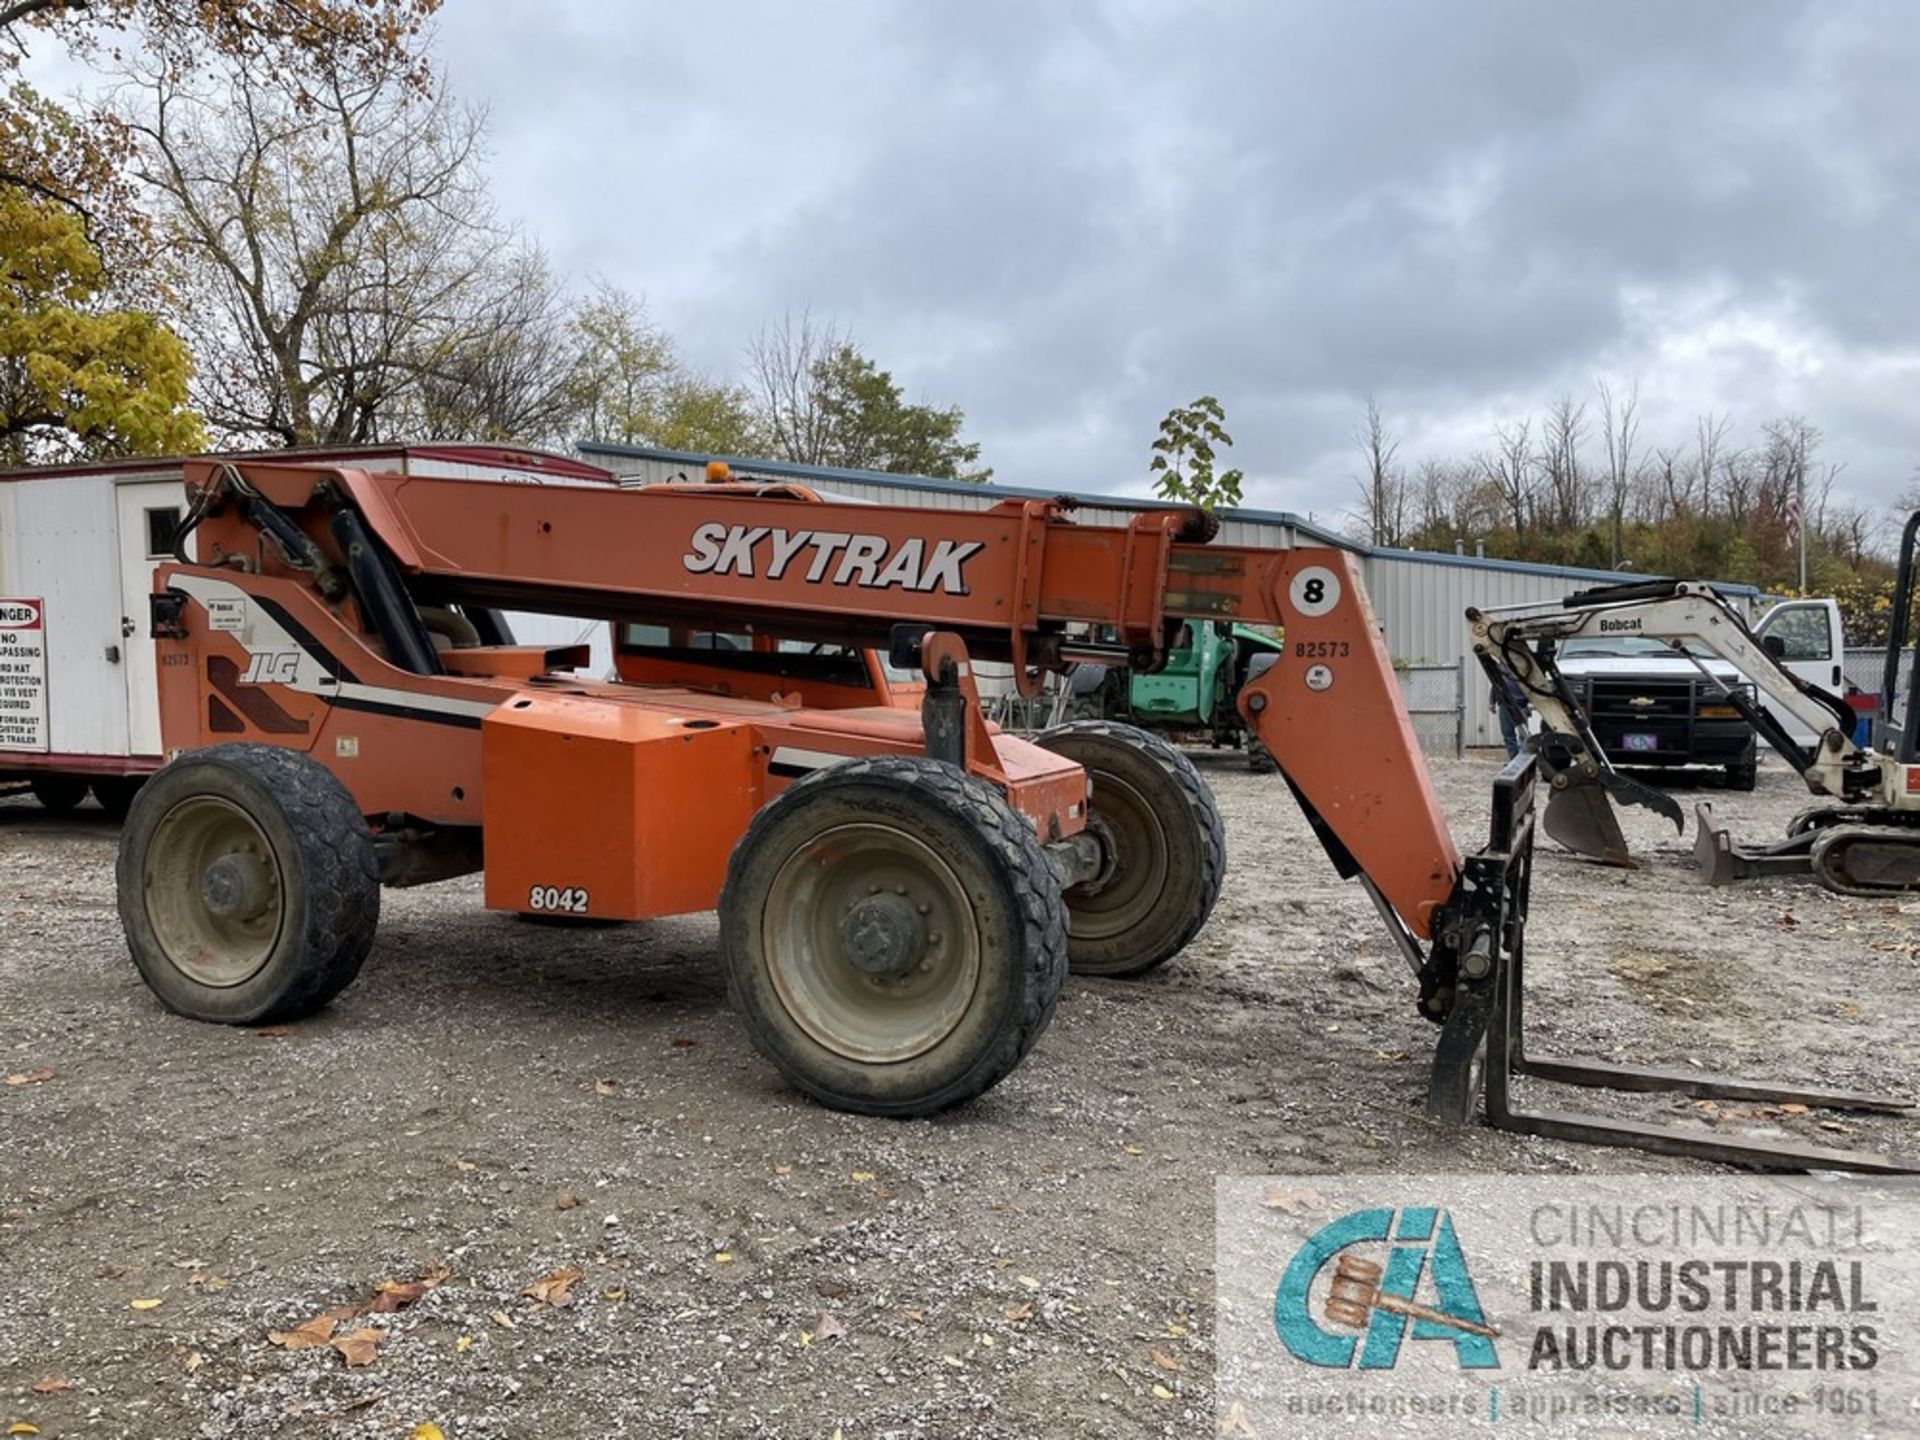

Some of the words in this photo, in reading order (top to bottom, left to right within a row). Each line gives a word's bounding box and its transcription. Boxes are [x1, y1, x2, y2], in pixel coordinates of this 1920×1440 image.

[683, 523, 985, 594] SKYTRAK
[1303, 578, 1325, 604] 8
[1600, 618, 1642, 632] Bobcat
[1, 633, 17, 644] NO
[1295, 642, 1349, 658] 82573
[0, 663, 12, 673] RD
[14, 664, 30, 673] HAT
[240, 652, 300, 684] JLG
[17, 688, 38, 698] VEST
[20, 717, 39, 725] MUST
[6, 735, 37, 744] TRAILER
[529, 885, 590, 913] 8042
